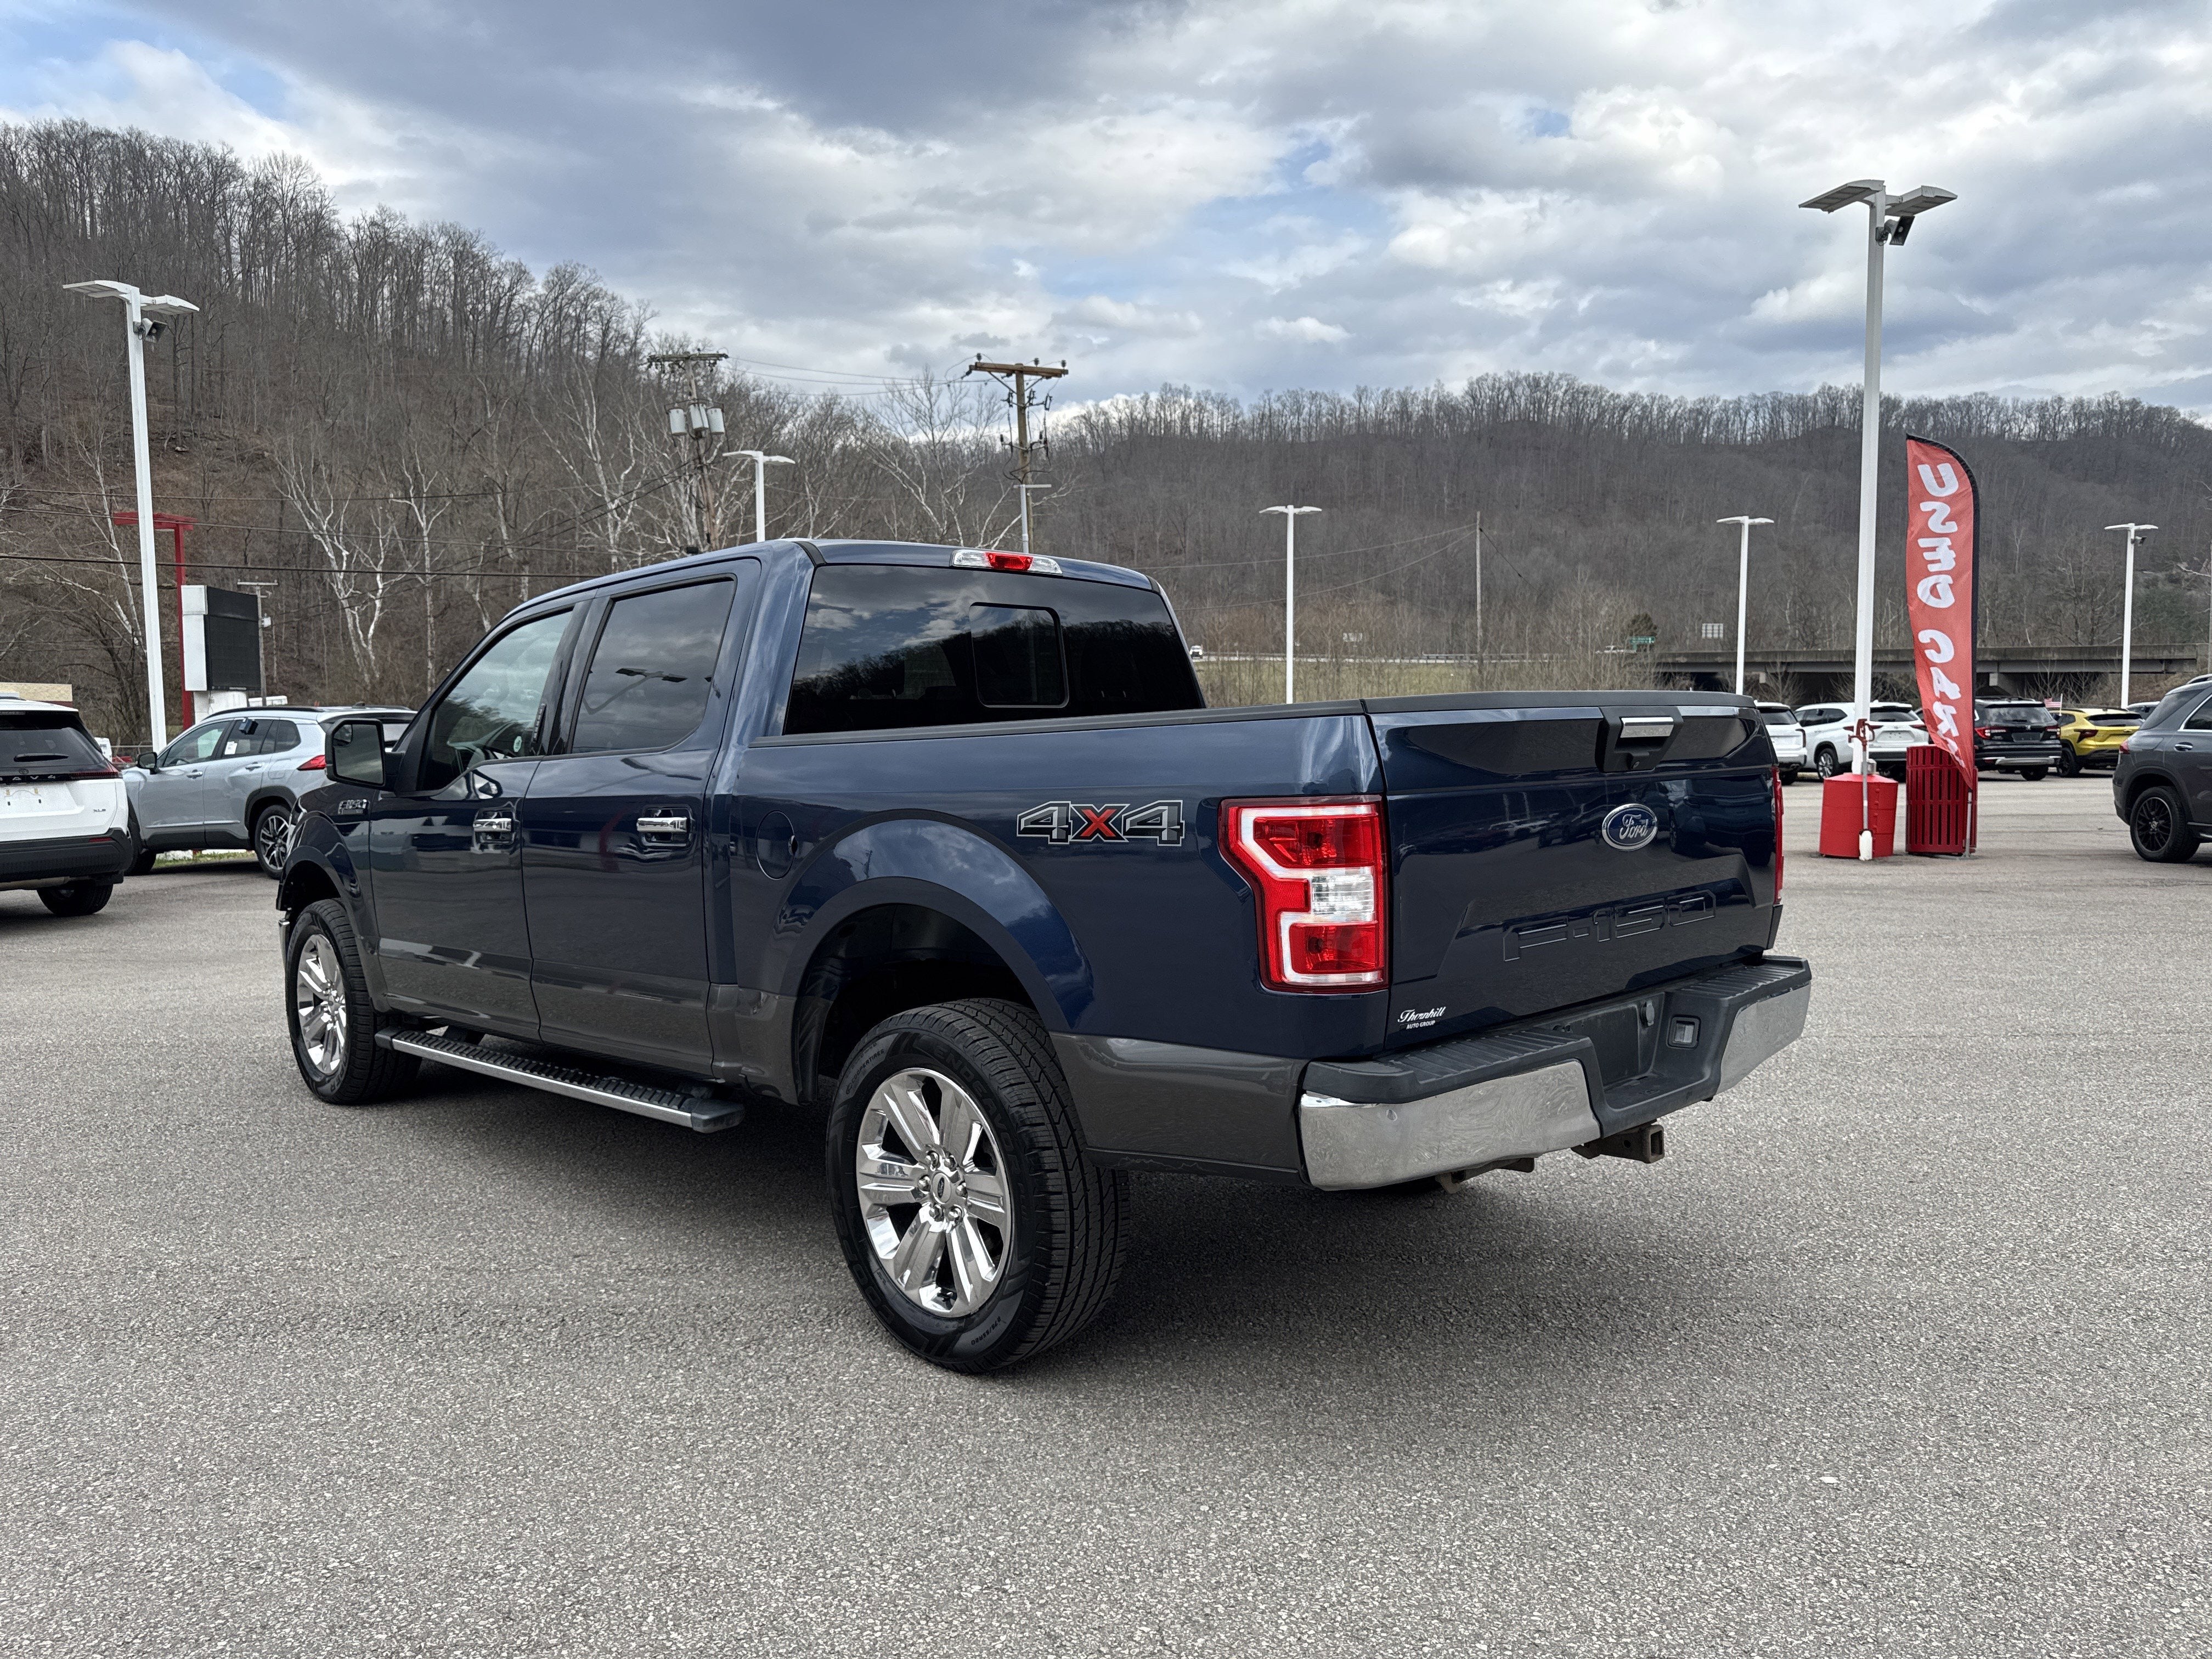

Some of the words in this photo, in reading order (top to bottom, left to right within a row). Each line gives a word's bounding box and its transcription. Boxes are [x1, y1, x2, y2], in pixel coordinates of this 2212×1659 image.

[1619, 814, 1649, 840] Ford
[1503, 889, 1717, 962] F-150
[1397, 1006, 1447, 1023] Thornhill
